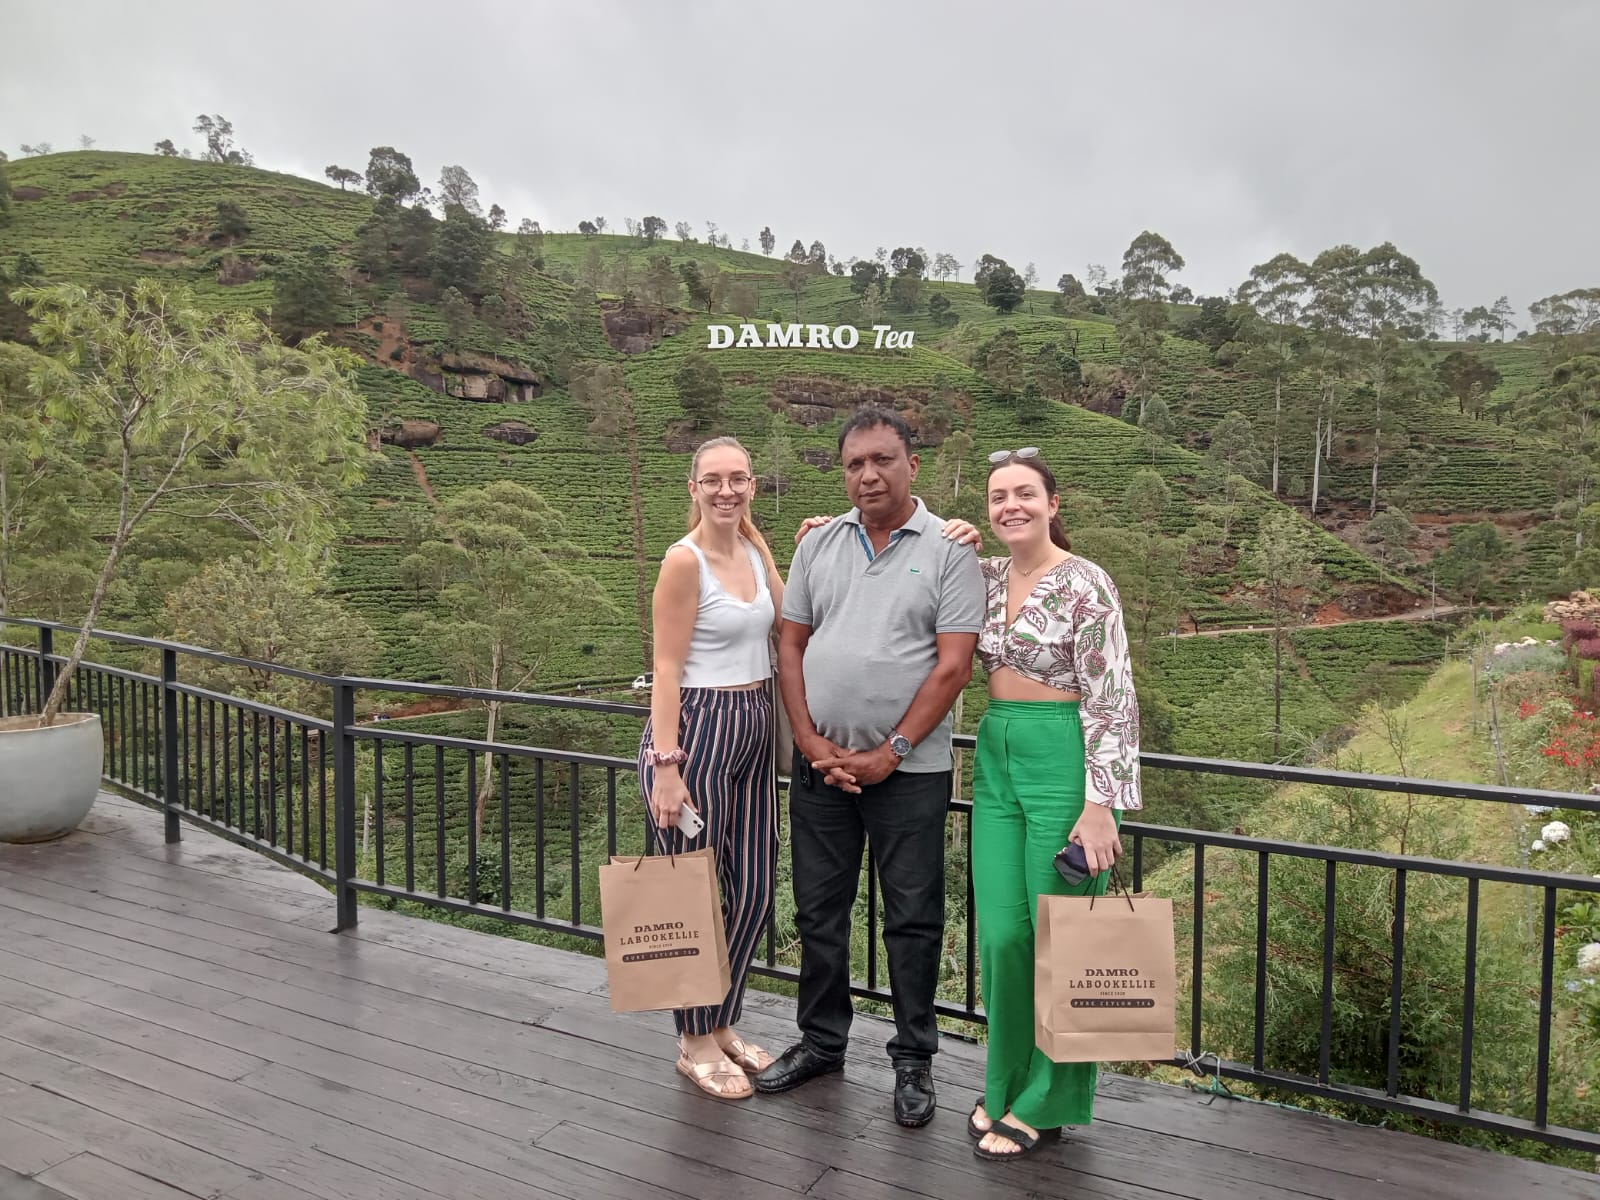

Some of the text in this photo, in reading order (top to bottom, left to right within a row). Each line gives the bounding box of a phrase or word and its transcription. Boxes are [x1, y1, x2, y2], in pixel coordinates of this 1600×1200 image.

[707, 323, 915, 350] DAMRO Tea
[634, 921, 684, 933] DAMRO
[620, 930, 700, 945] LABOOKELLIE
[1085, 968, 1139, 977] DAMRO
[1069, 980, 1156, 989] LABOOKELLIE
